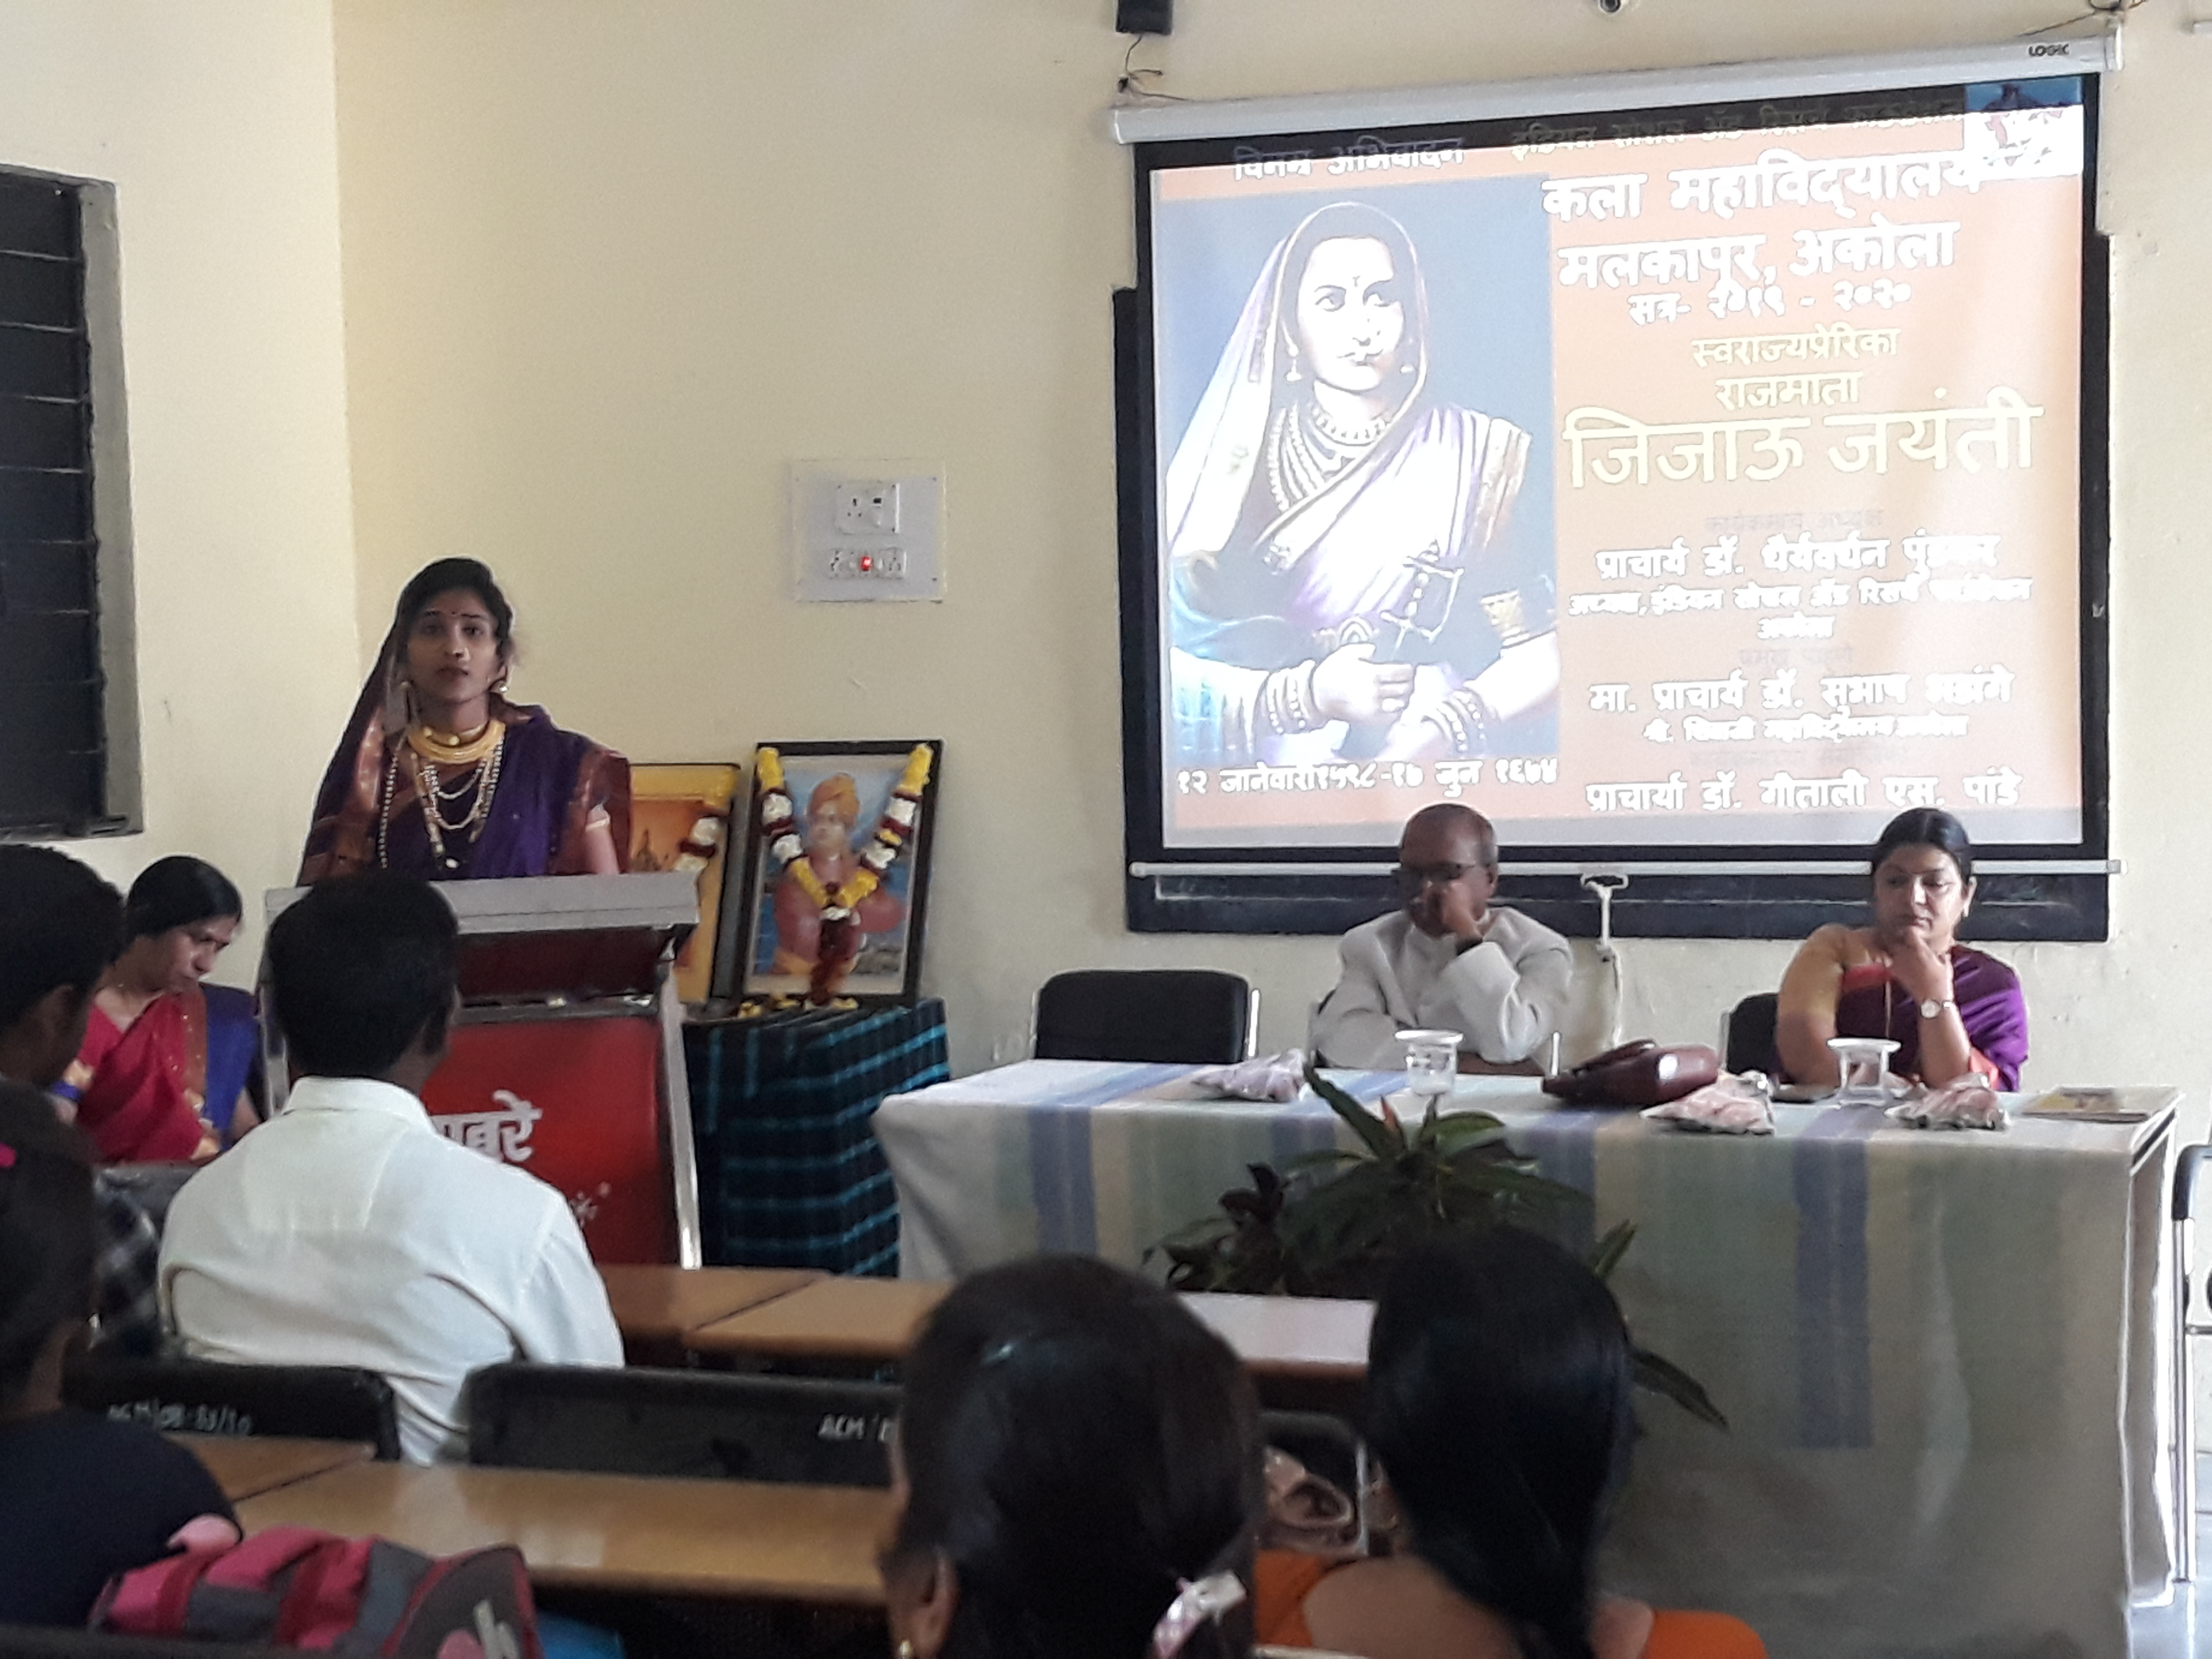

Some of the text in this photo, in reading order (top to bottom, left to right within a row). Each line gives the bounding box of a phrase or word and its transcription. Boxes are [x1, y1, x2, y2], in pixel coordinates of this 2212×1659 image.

[1541, 173, 1648, 222] कला
[1788, 211, 1961, 279] अकोला
[1691, 323, 1902, 368] स्वराज्यप्रेरिका
[1715, 370, 1864, 410] राजमाता
[1560, 385, 2045, 489] जिजाऊ जयंती
[1595, 535, 1690, 579] प्राचार्य
[1701, 534, 1745, 576] डॉ.
[1653, 668, 1749, 712] प्राचार्य
[1700, 770, 1742, 811] डॉ.
